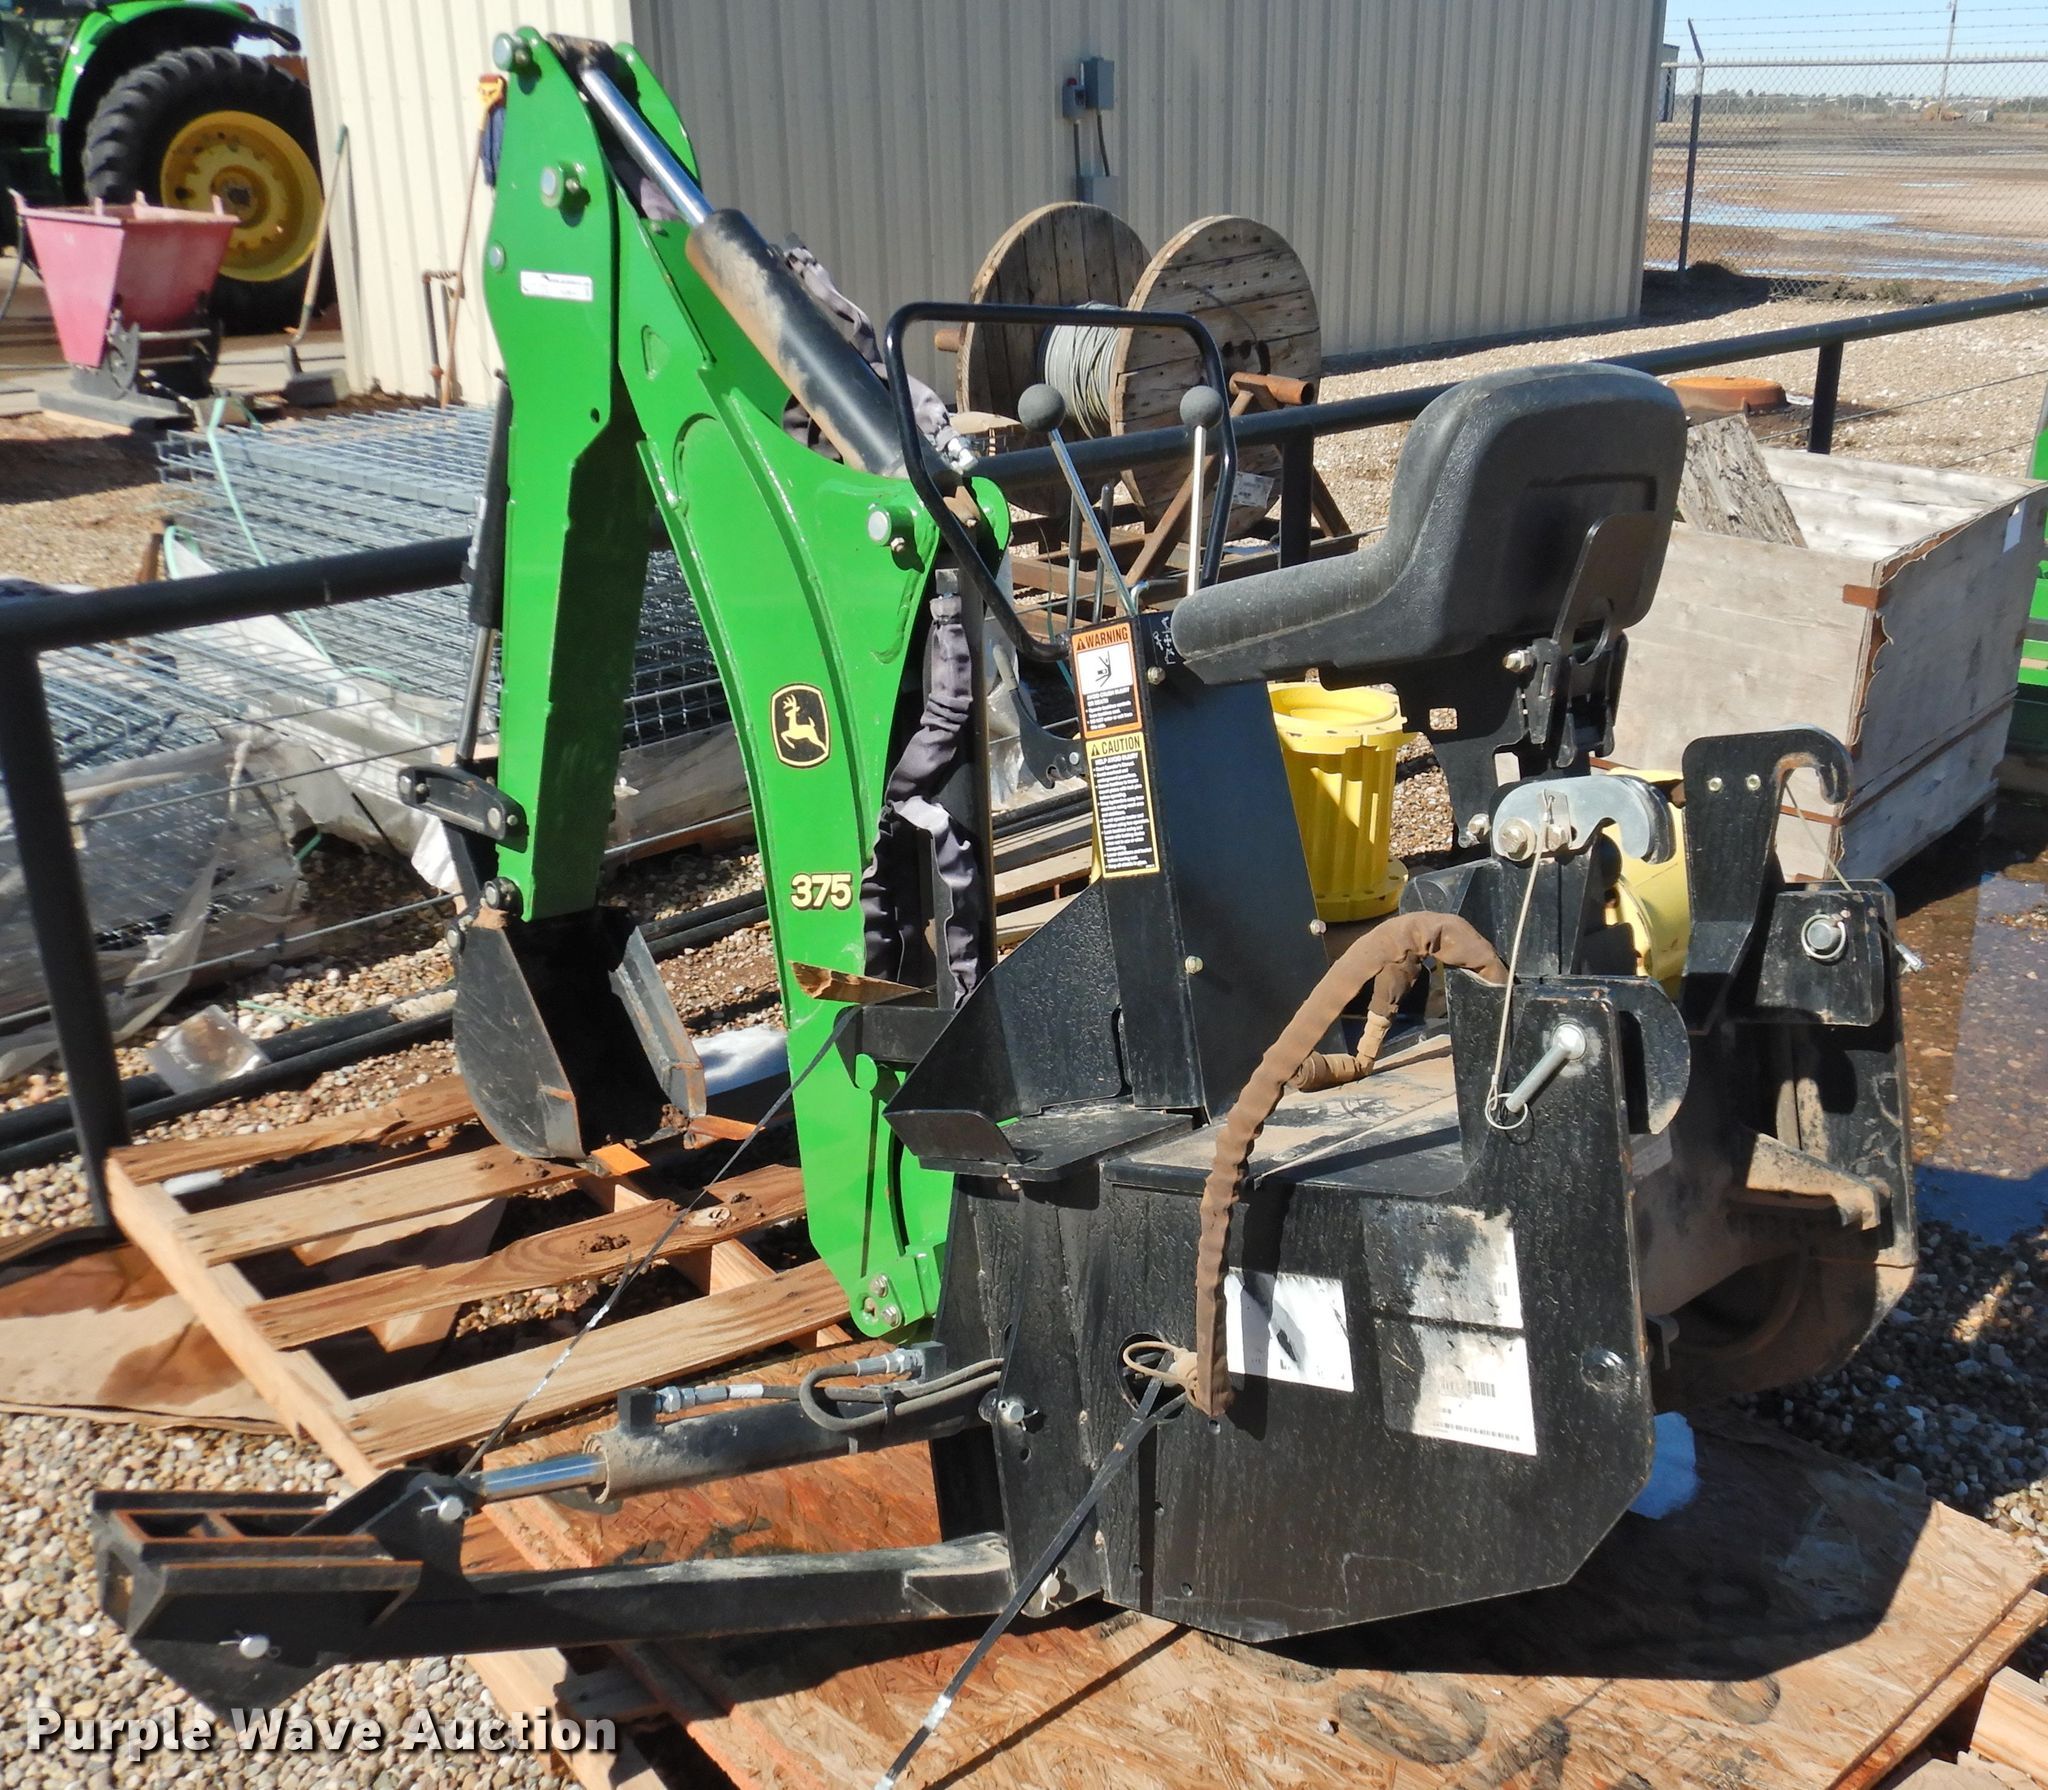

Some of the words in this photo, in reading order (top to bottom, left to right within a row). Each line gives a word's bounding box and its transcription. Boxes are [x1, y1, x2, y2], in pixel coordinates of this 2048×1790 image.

[1085, 626, 1129, 649] WARNING
[1101, 735, 1141, 755] CAUTION
[791, 872, 853, 910] 375
